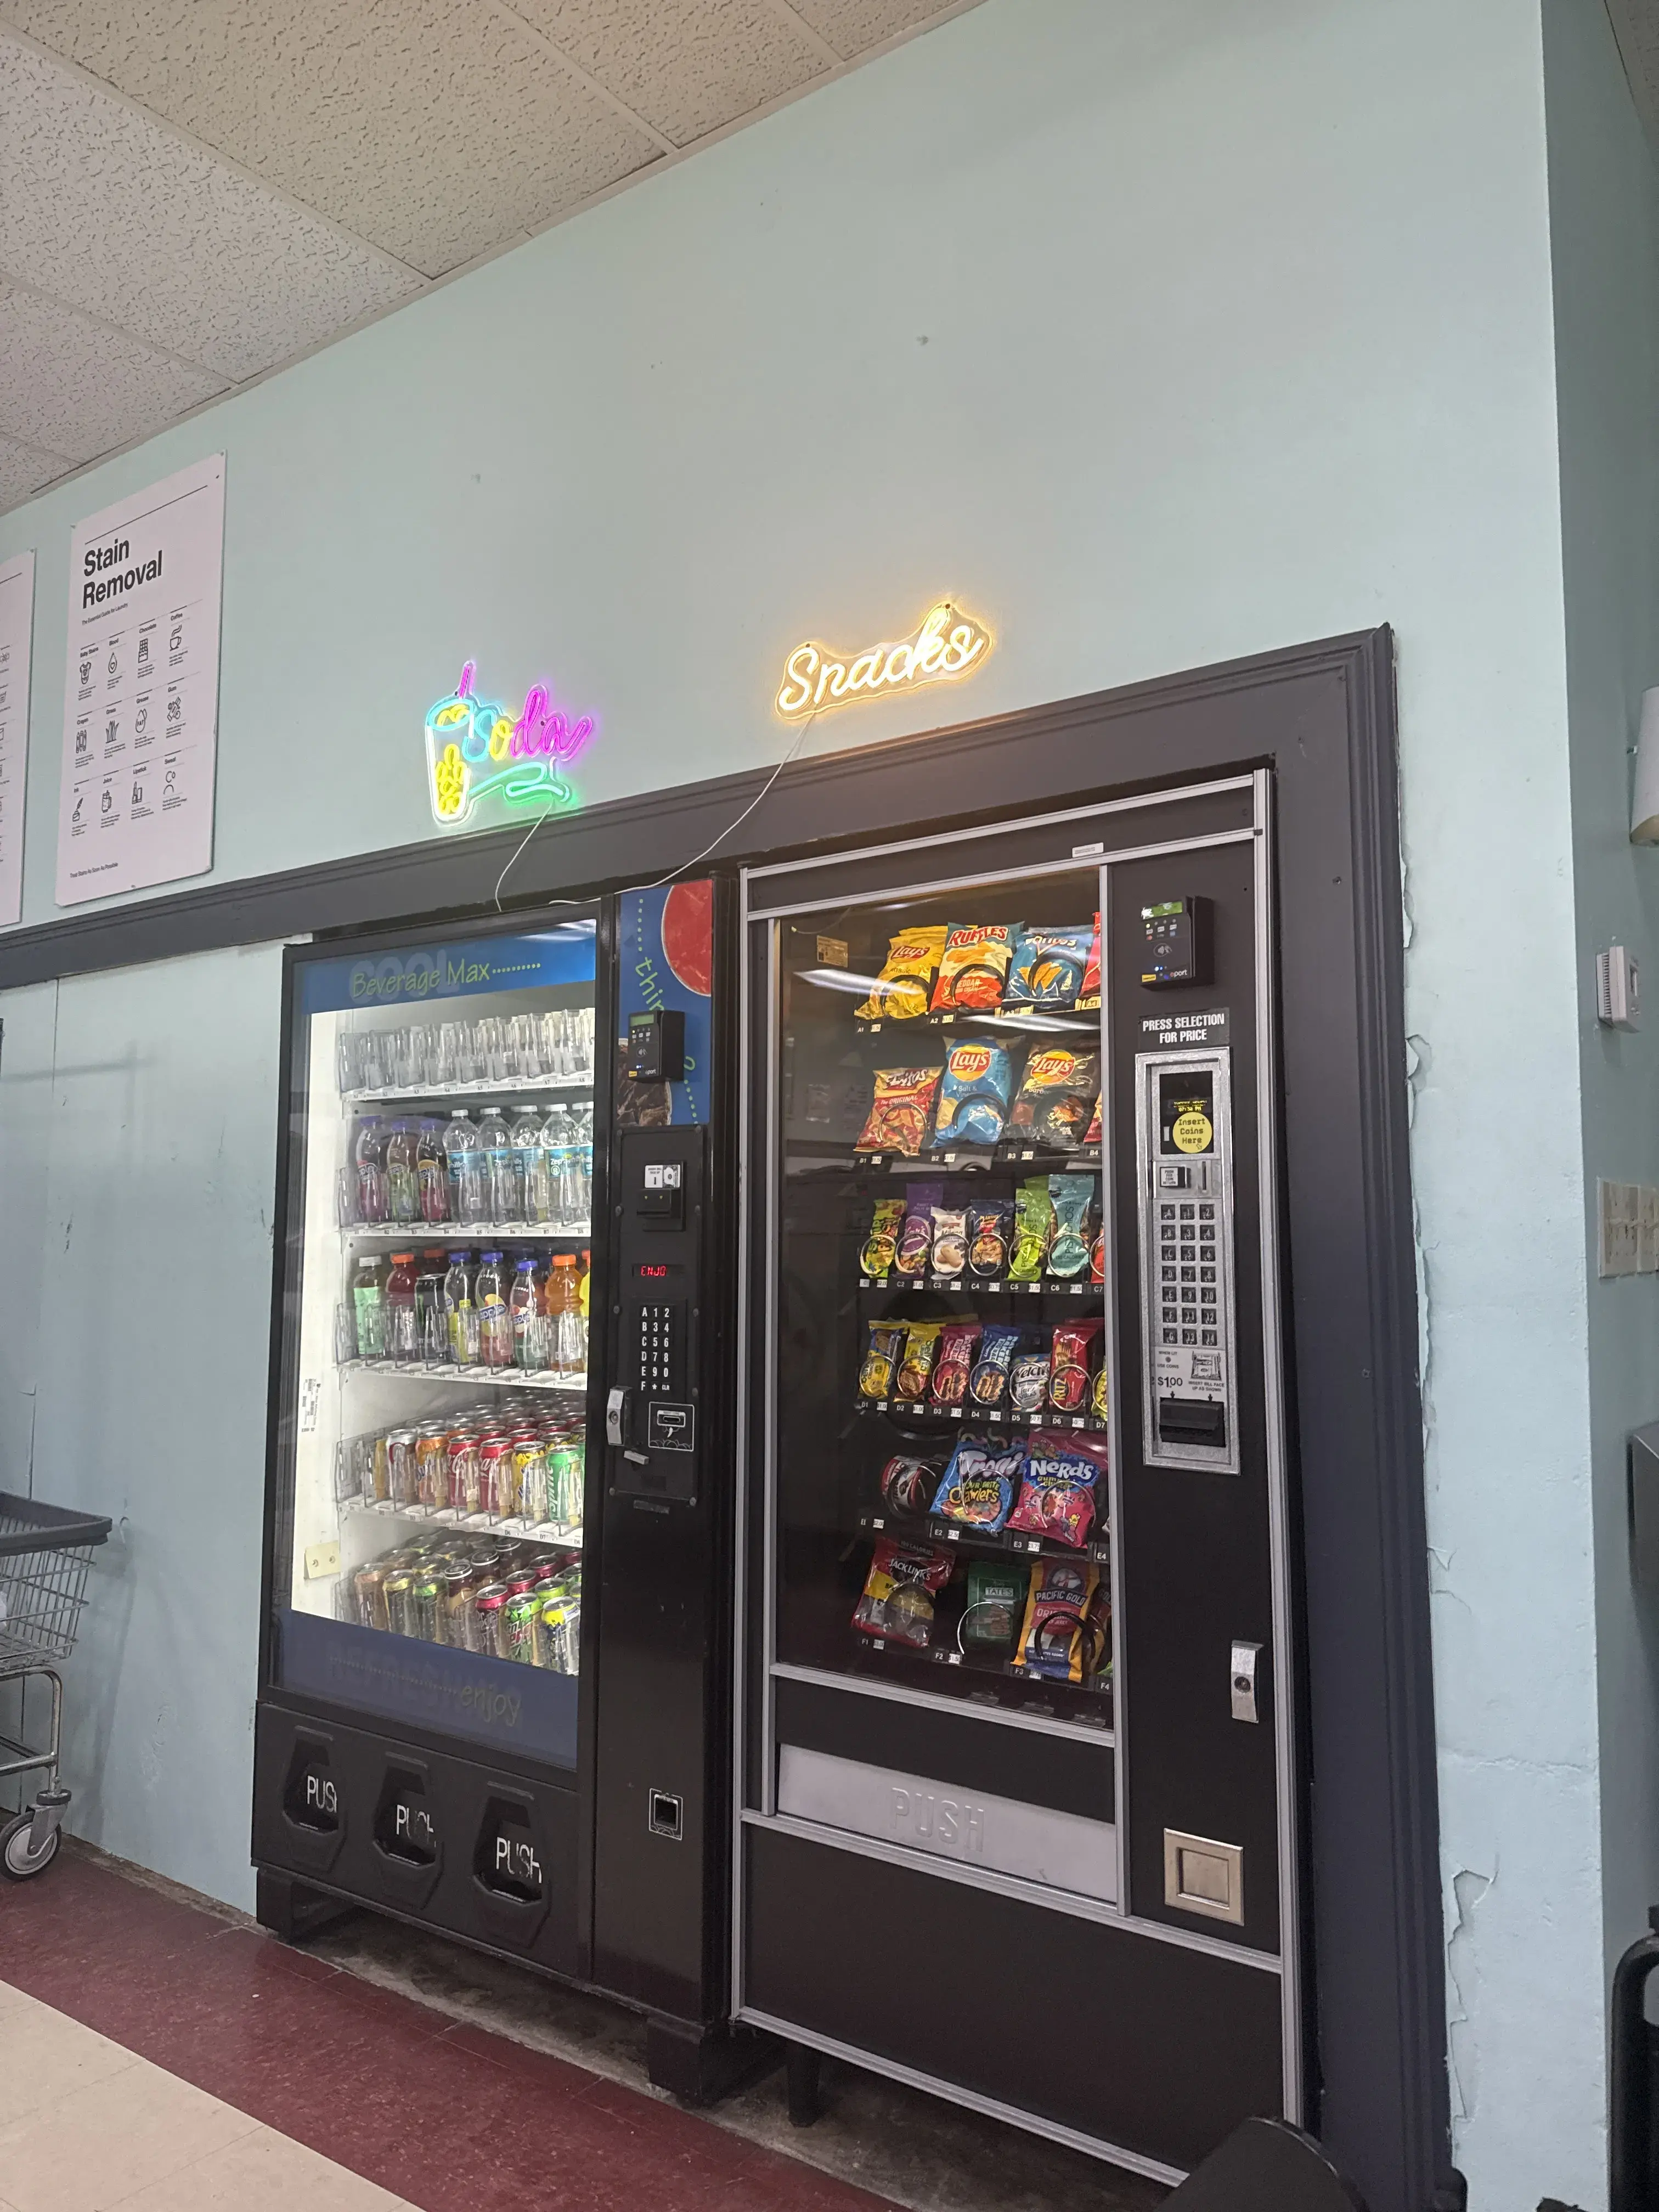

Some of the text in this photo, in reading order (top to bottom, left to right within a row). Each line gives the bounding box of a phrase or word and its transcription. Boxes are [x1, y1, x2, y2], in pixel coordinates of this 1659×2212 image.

[84, 539, 129, 577] Stain
[83, 550, 162, 609] Removal
[115, 603, 128, 611] Laundry
[778, 607, 984, 711] Snacks
[462, 690, 592, 763] Soda
[947, 927, 1008, 946] RUFFLES
[352, 958, 490, 997] Beverage Max
[1143, 1013, 1224, 1031] PRESS SELECTION
[1160, 1029, 1207, 1043] FOR PRICE
[885, 1069, 928, 1087] Fritos
[889, 1095, 918, 1104] ORIGINAL
[642, 1307, 669, 1318] A 1 2
[642, 1322, 669, 1332] B 3 4
[642, 1336, 669, 1347] C 5 6
[641, 1351, 669, 1363] D 7 8
[641, 1366, 668, 1378] E 9 0
[641, 1381, 646, 1391] F
[1053, 1378, 1067, 1400] RITZ
[1158, 1376, 1183, 1389] $1.00
[958, 1451, 1024, 1477] Trolli
[982, 1481, 1000, 1489] BRITE
[949, 1487, 1000, 1504] Cawlers
[888, 1559, 907, 1572] JACK
[1036, 1591, 1086, 1606] PACIFIC GOLD
[461, 1682, 521, 1726] enjoy
[891, 1787, 984, 1852] PUSH
